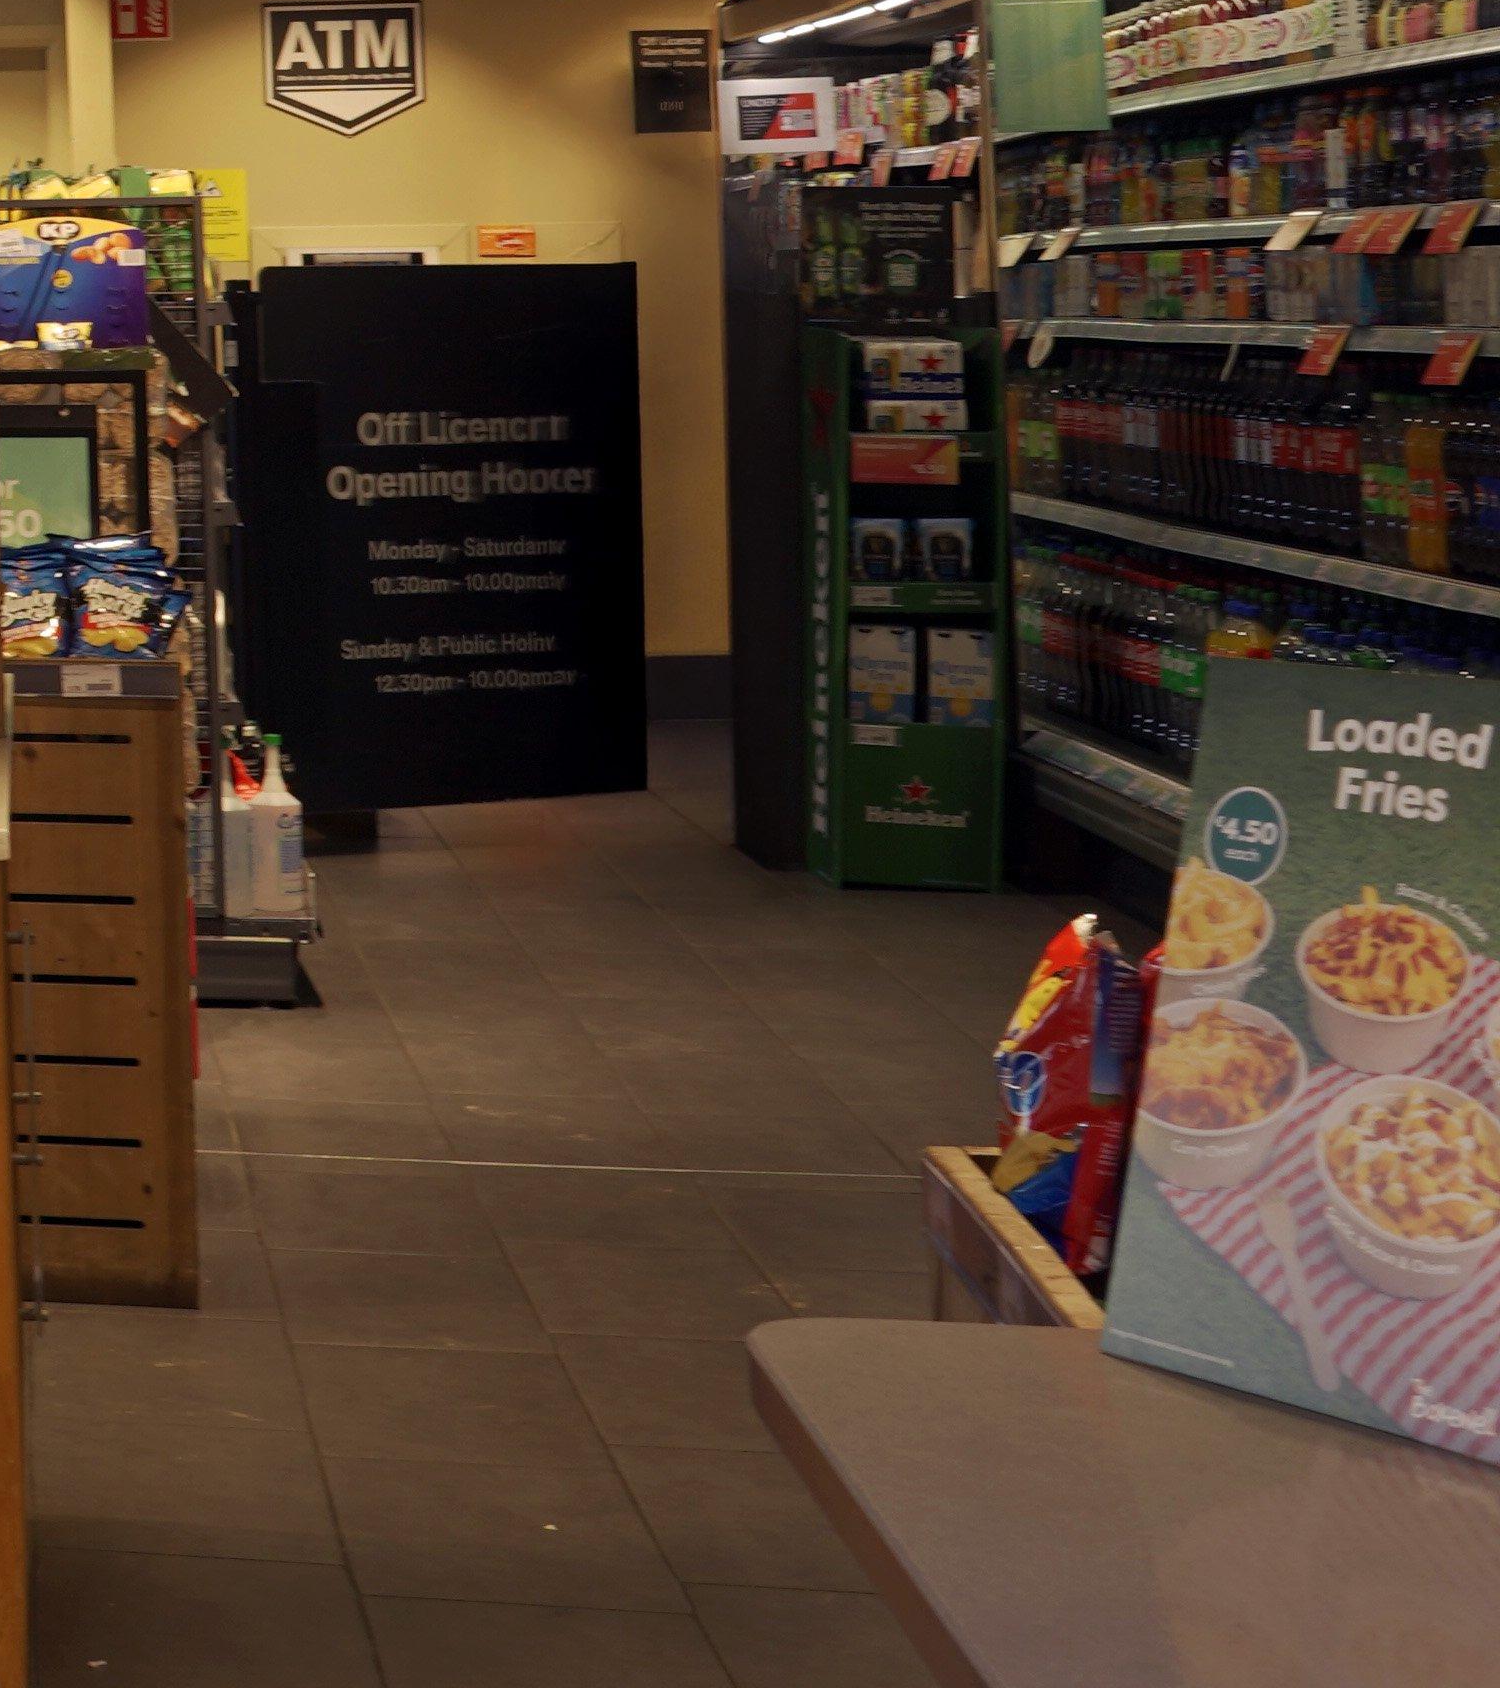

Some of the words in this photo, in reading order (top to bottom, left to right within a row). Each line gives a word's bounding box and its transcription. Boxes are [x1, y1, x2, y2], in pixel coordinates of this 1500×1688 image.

[275, 18, 410, 71] ATM
[357, 411, 412, 447] Off
[325, 464, 478, 506] Opening
[1306, 709, 1495, 770] Loaded
[1333, 766, 1451, 823] Fries
